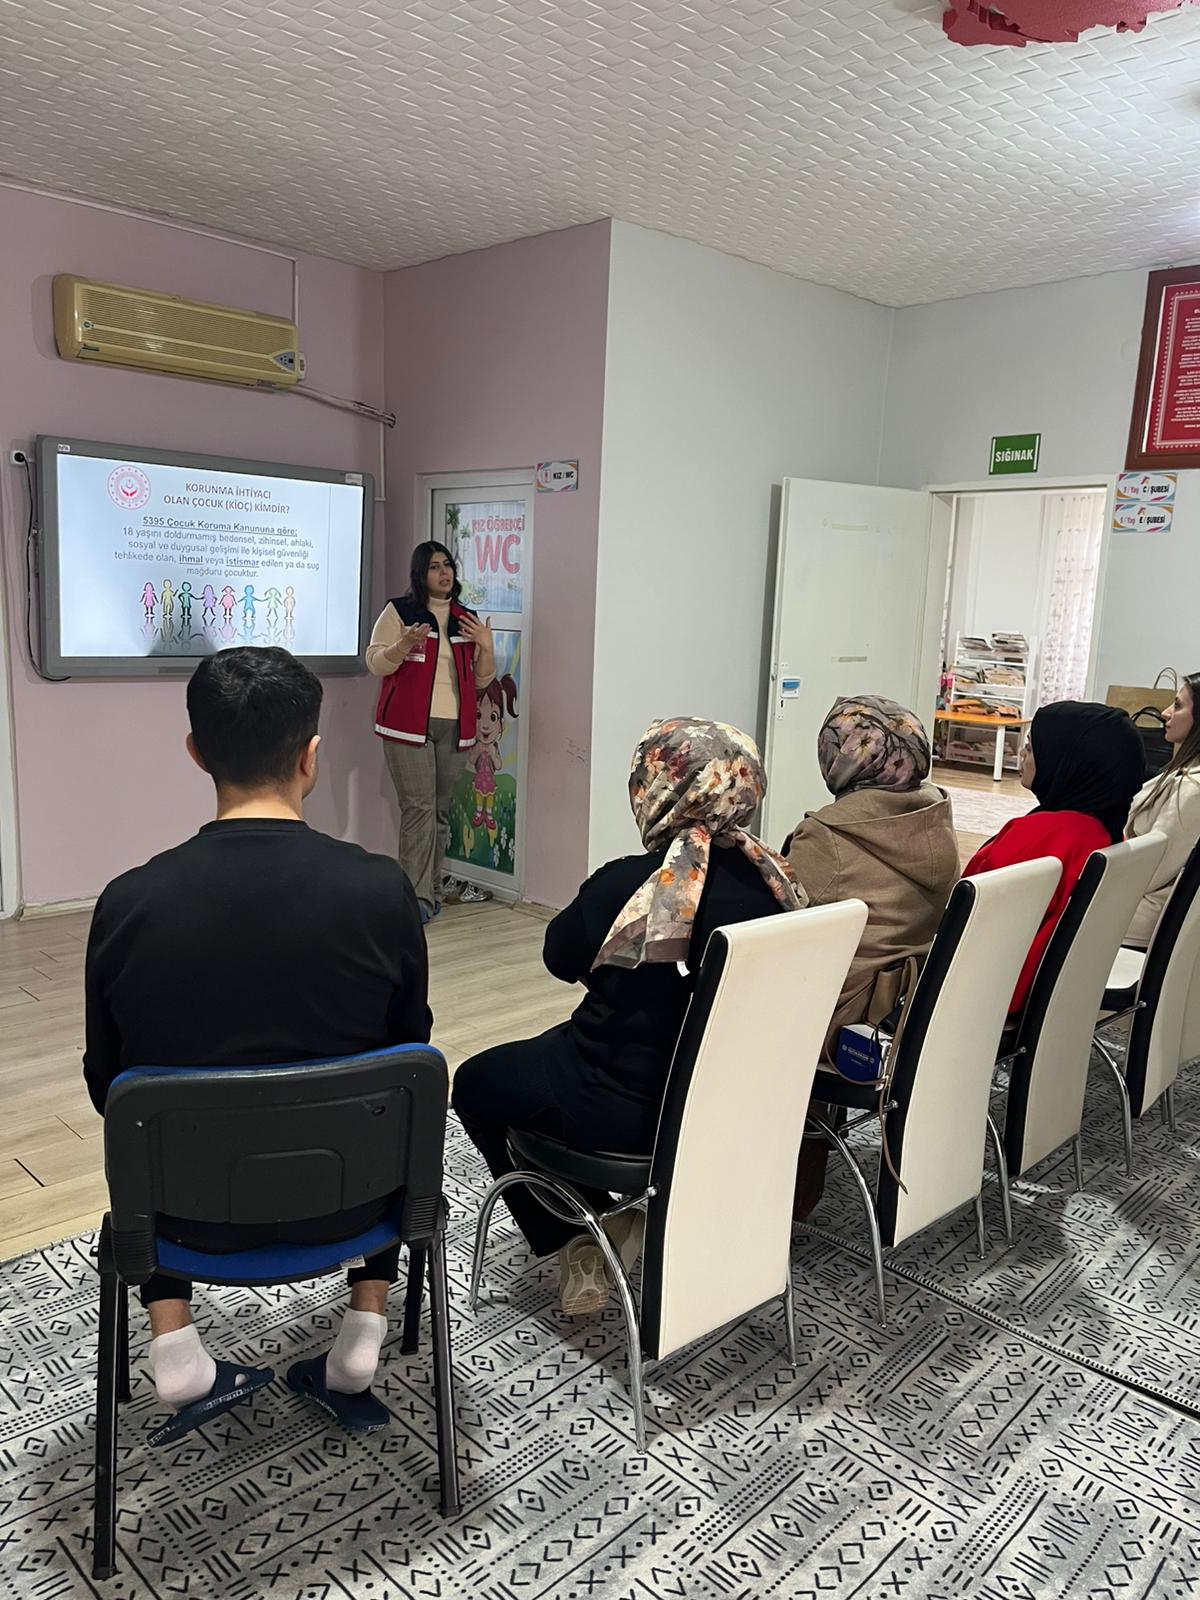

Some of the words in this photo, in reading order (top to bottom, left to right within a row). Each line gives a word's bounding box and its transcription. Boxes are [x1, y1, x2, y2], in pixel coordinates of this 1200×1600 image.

[995, 448, 1034, 463] SIĞINAK
[566, 471, 574, 479] WC
[185, 483, 234, 496] KORUNMA
[235, 485, 271, 499] İHTİYACI
[1151, 484, 1170, 495] ŞUBESİ
[163, 495, 190, 505] OLAN
[192, 497, 223, 508] ÇOCUK
[225, 499, 253, 512] (KİOÇ)
[254, 501, 290, 514] KİMDİR?
[143, 516, 165, 526] 5395
[167, 518, 195, 528] Çocuk
[197, 520, 231, 531] Koruma
[233, 522, 275, 533] Kanununa
[487, 514, 525, 532] ÖĞRENCİ
[123, 527, 134, 536] 18
[135, 528, 161, 539] yaşını
[164, 530, 217, 542] doldurmamış
[219, 534, 256, 544] bedensel,
[258, 537, 289, 547] zihinsel,
[128, 541, 156, 551] sosyal
[170, 542, 207, 553] duygusal
[209, 544, 239, 555] gelişimi
[240, 546, 250, 555] ile
[251, 547, 275, 557] kişisel
[475, 533, 521, 574] WC
[114, 551, 154, 561] tehlikede
[155, 554, 177, 563] olan,
[179, 554, 204, 564] ihmal
[205, 556, 224, 566] veya
[226, 556, 259, 567] istismar
[260, 559, 283, 568] edilen
[285, 561, 294, 570] ya
[296, 560, 305, 569] da
[307, 562, 320, 571] suç
[186, 567, 222, 577] mağduru
[223, 569, 259, 578] çocuktur.
